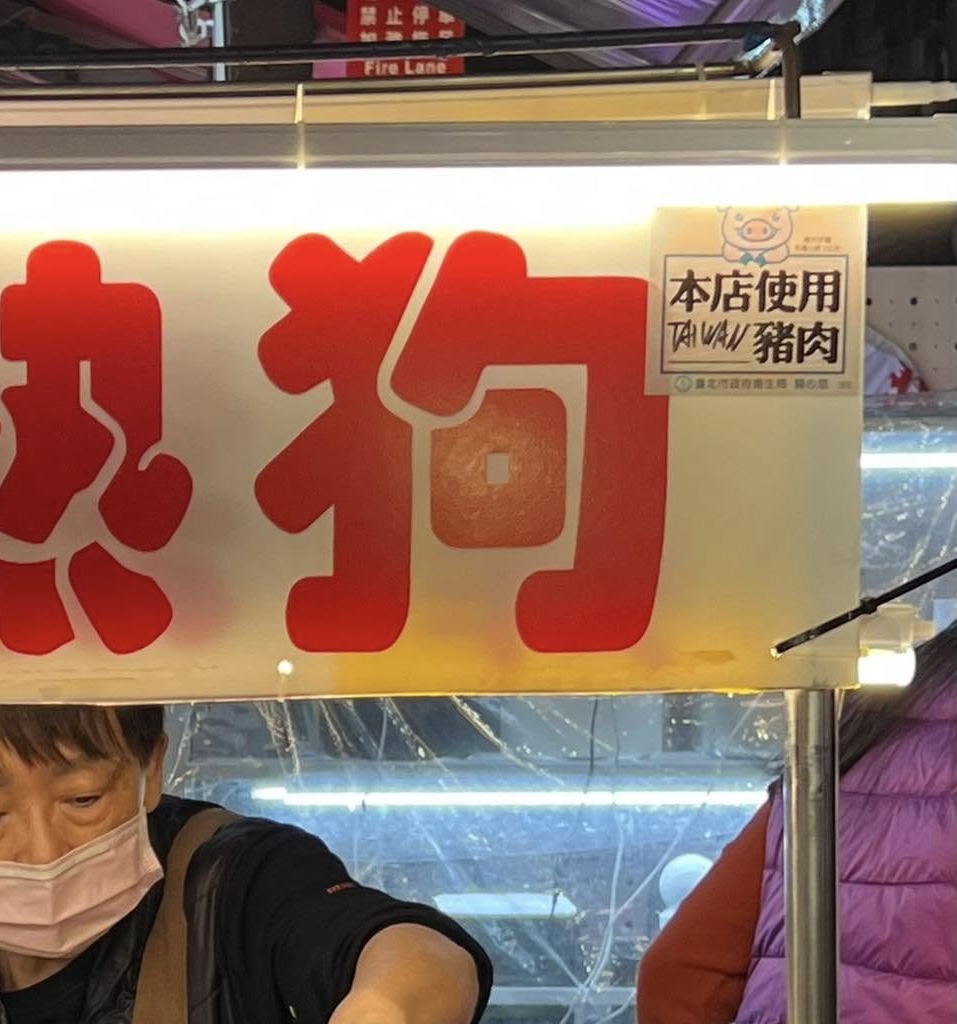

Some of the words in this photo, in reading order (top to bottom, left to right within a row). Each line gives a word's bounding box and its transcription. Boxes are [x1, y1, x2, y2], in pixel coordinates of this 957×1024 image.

[364, 60, 399, 75] Fire
[404, 60, 447, 75] Lane
[669, 269, 842, 313] 本店使用
[667, 319, 750, 353] TAIWAN
[752, 321, 840, 364] 豬肉
